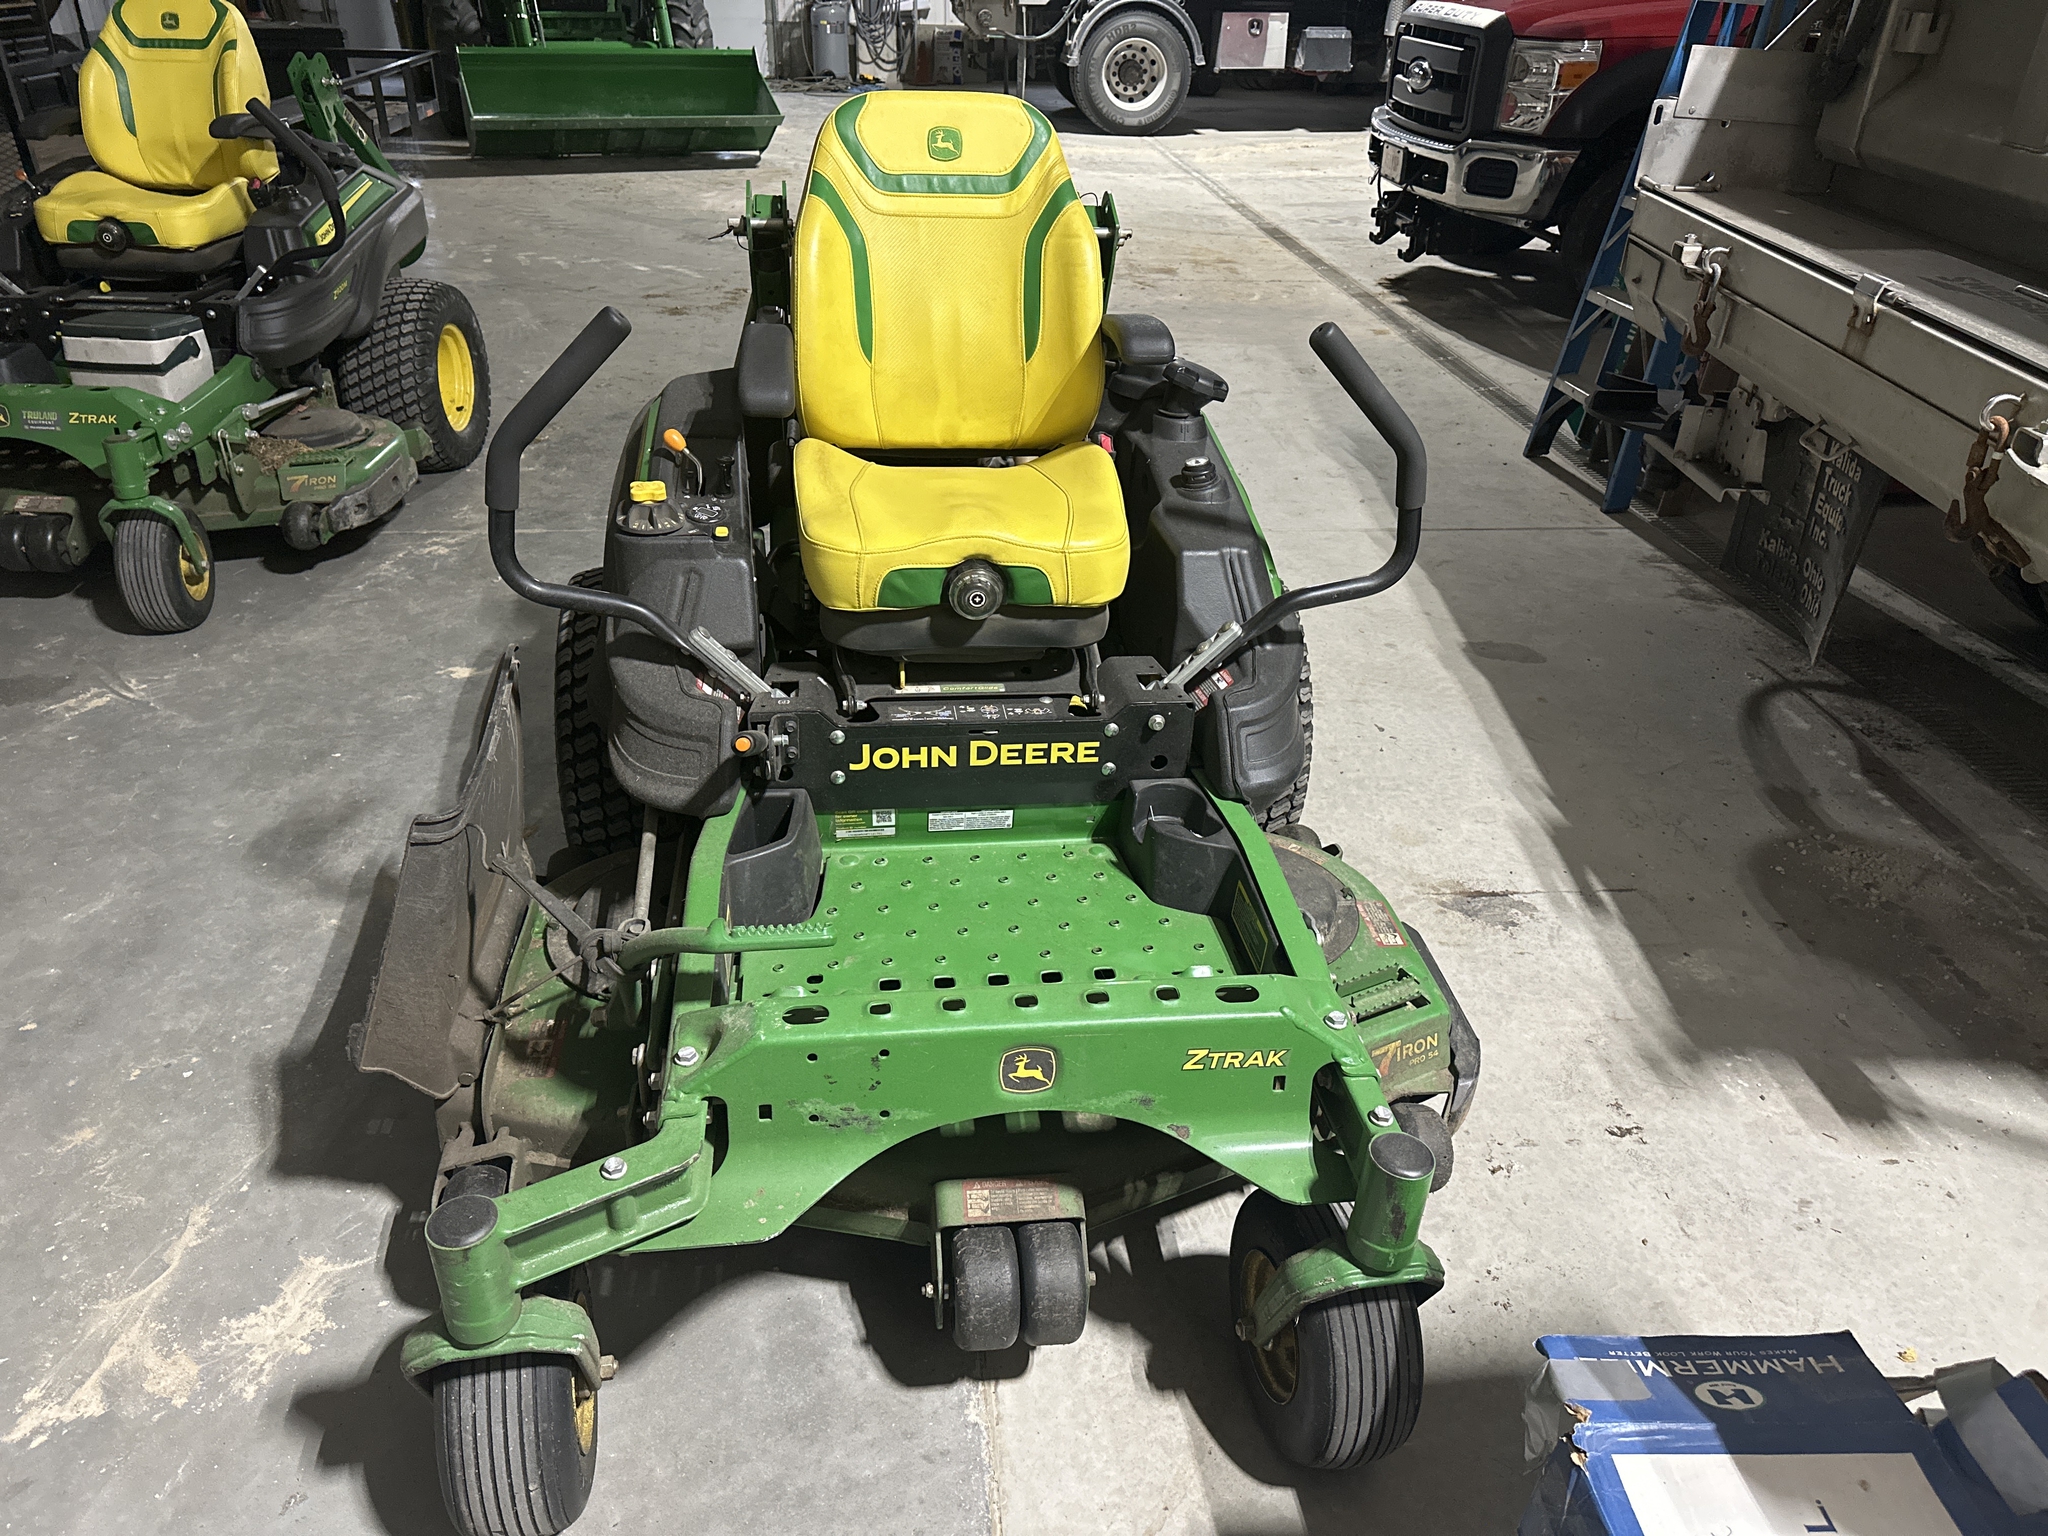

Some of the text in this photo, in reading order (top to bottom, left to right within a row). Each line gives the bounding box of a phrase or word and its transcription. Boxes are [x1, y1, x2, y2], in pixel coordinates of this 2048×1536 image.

[22, 410, 58, 421] TRULAND
[68, 412, 117, 424] ZTRAK
[1823, 466, 1852, 506] Truck
[1803, 558, 1825, 592] Ohio
[1800, 583, 1822, 618] Ohio
[849, 740, 1100, 770] JOHN DEERE
[1181, 1048, 1290, 1070] ZTRAK
[1409, 1049, 1439, 1066] PRO 54
